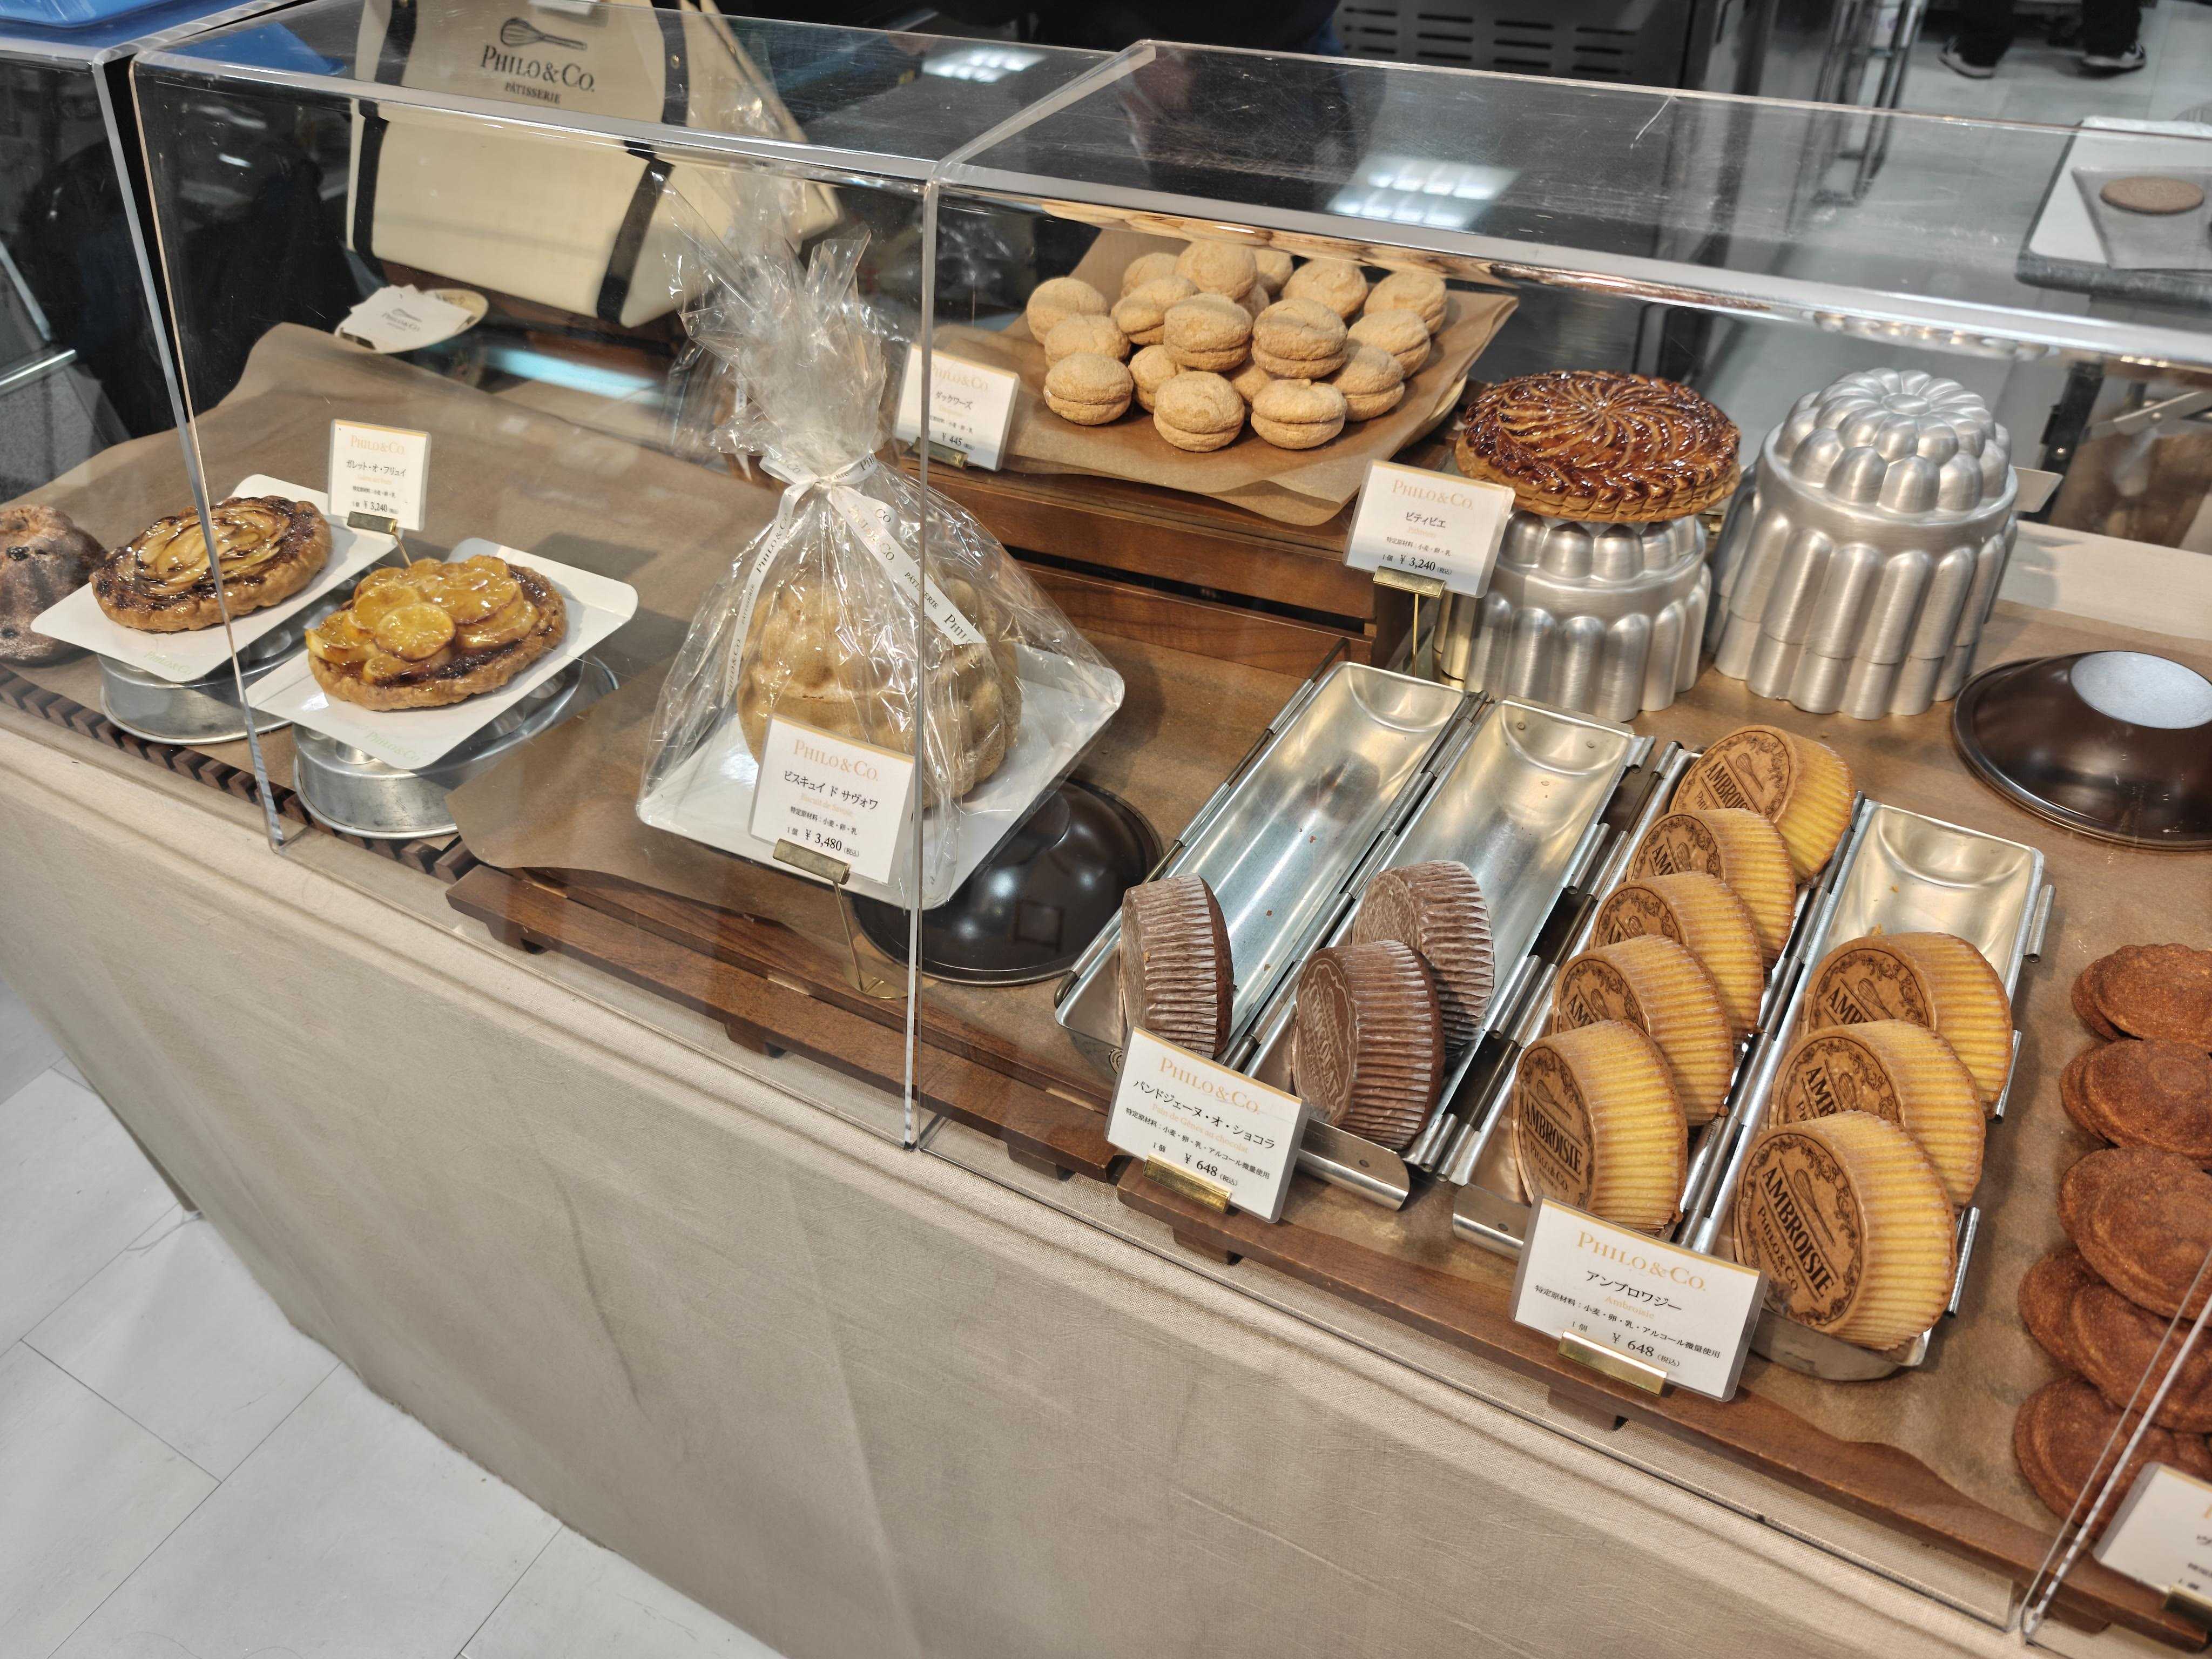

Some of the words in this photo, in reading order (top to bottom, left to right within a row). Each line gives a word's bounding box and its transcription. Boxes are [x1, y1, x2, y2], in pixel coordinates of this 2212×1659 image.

[480, 44, 595, 92] PHILO&CO.
[949, 435, 963, 446] 445
[1409, 557, 1436, 571] 3,240
[814, 833, 843, 852] 3,480
[1158, 1056, 1259, 1115] PHILO&CO.
[1133, 1081, 1275, 1149] パンドジェーヌ・オ・ショコラ
[1525, 1097, 1582, 1176] AMBROISIE
[1196, 1160, 1218, 1177] 648
[1762, 1166, 1835, 1298] AMBROISIE
[1577, 1231, 1707, 1291] PHILO&CO.
[1586, 1270, 1682, 1311] アンブロワジー
[1603, 1295, 1655, 1319] Ambroisie
[1627, 1339, 1655, 1358] 648
